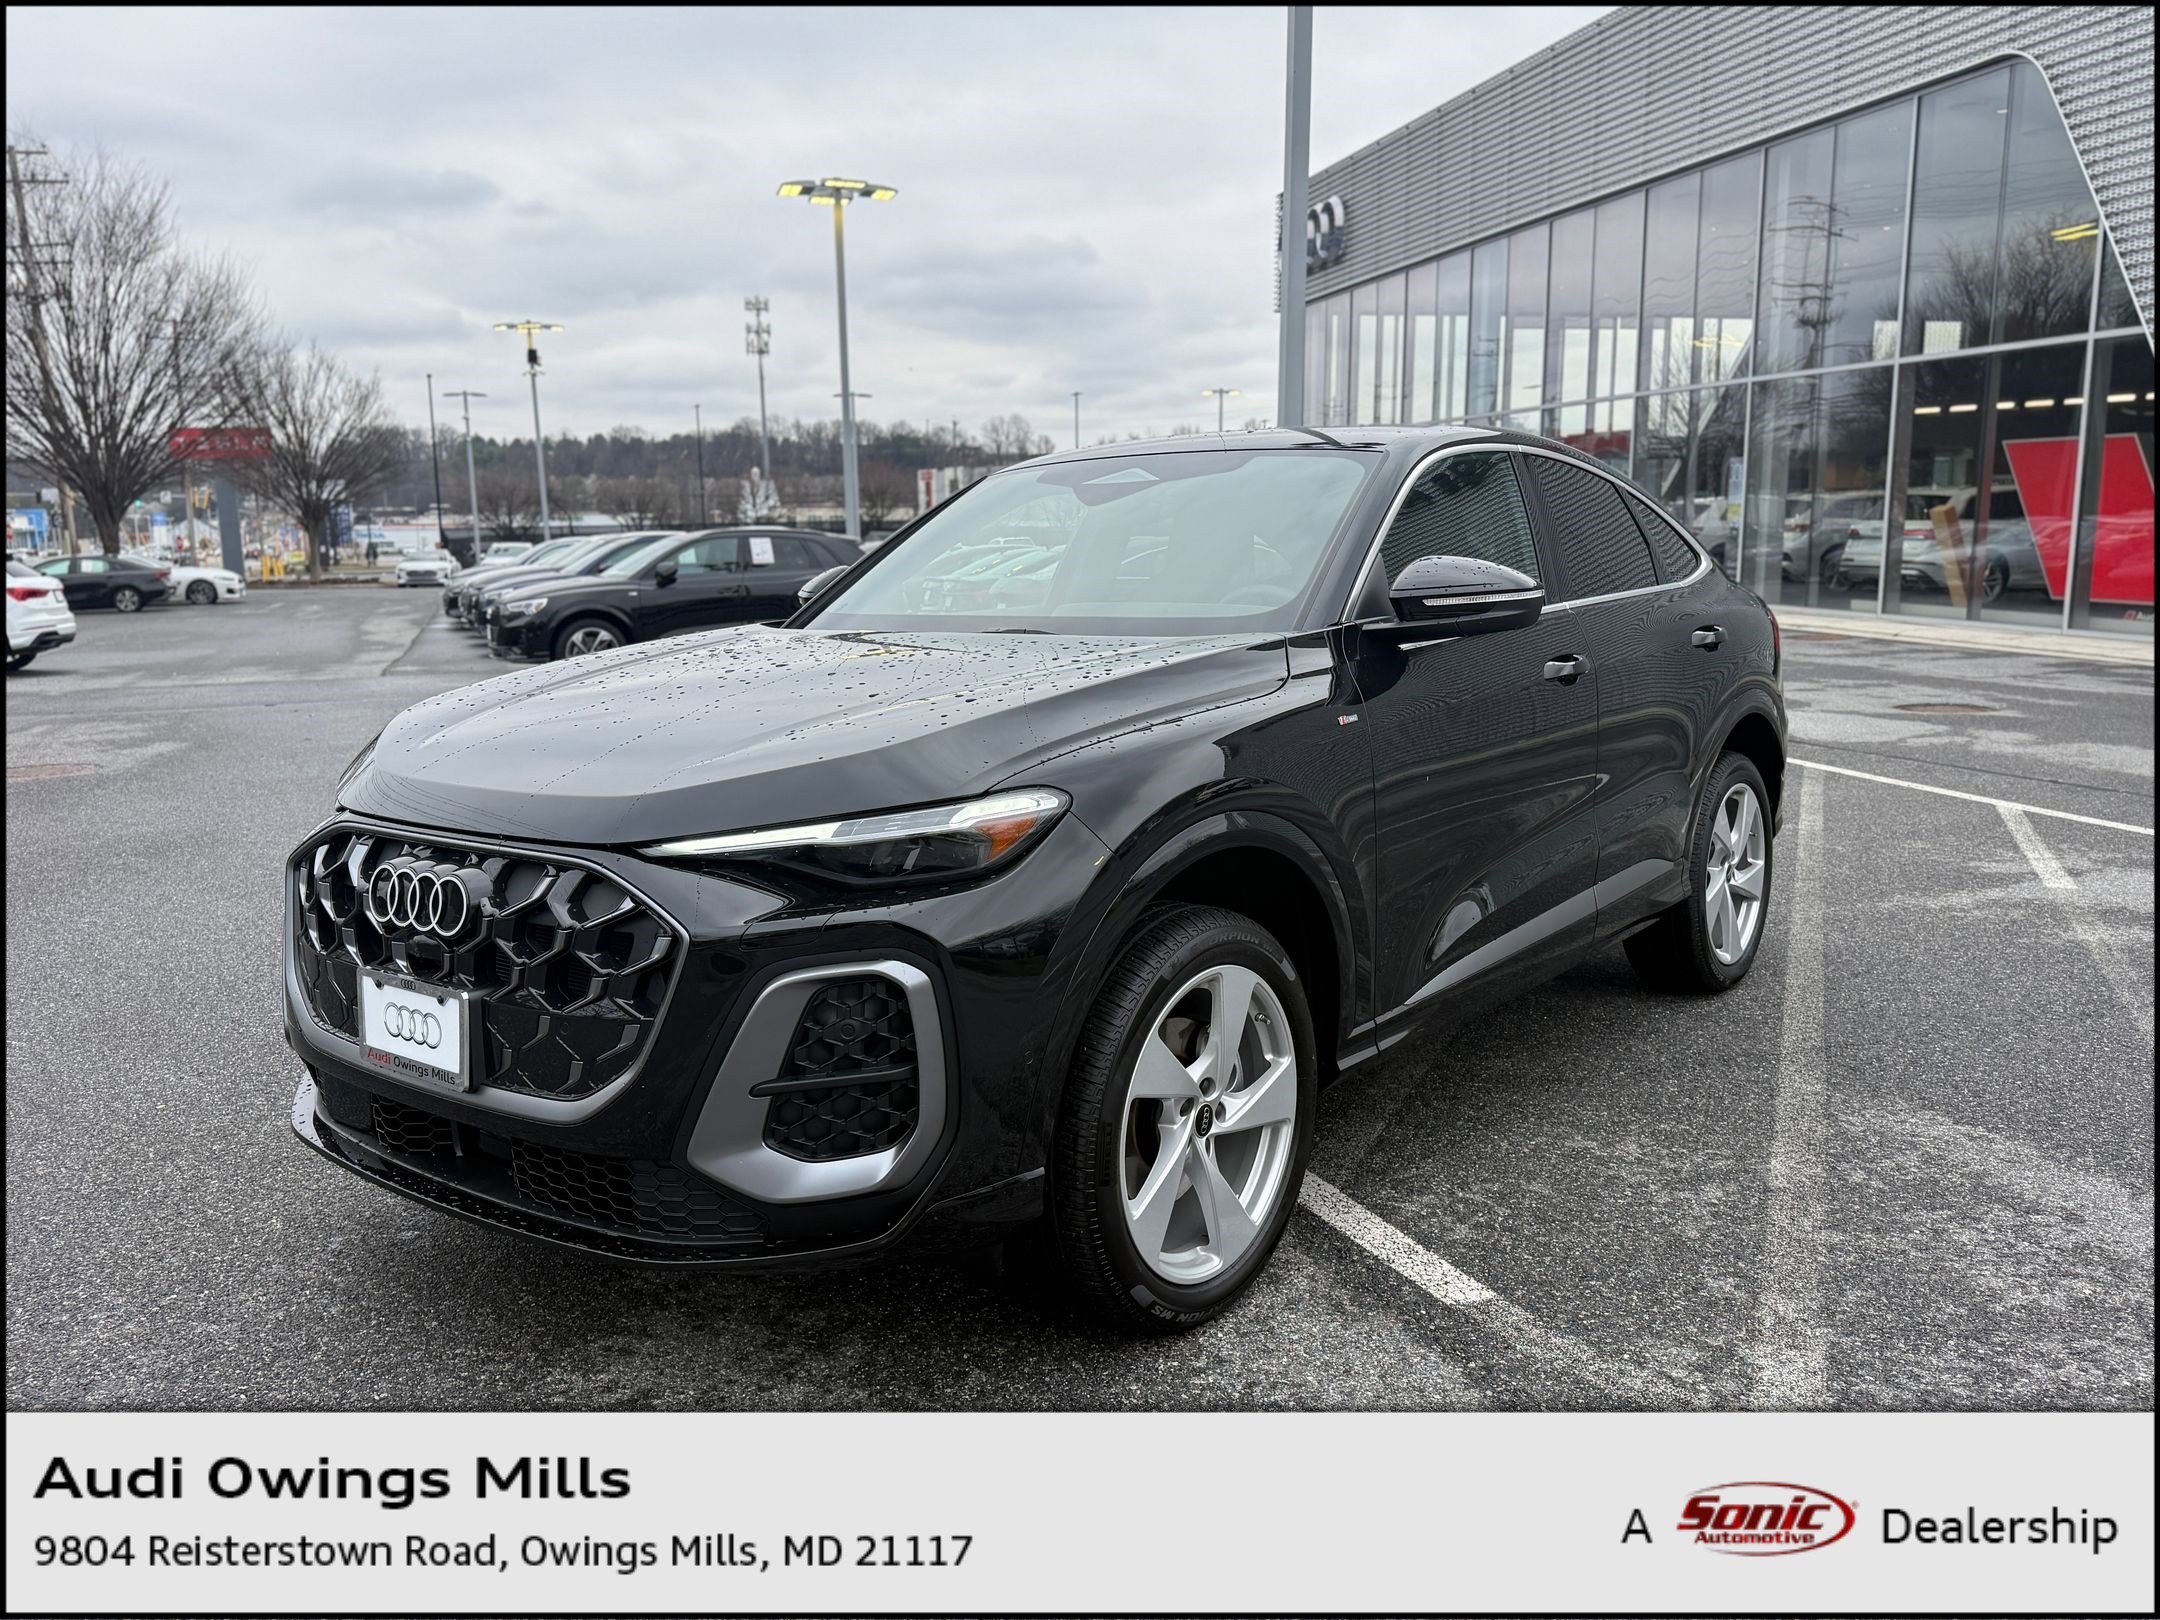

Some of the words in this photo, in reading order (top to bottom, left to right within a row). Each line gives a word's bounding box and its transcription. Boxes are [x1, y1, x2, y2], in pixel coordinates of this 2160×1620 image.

[367, 1047, 391, 1064] Audi
[393, 1056, 429, 1077] Owings
[431, 1067, 456, 1085] Mills
